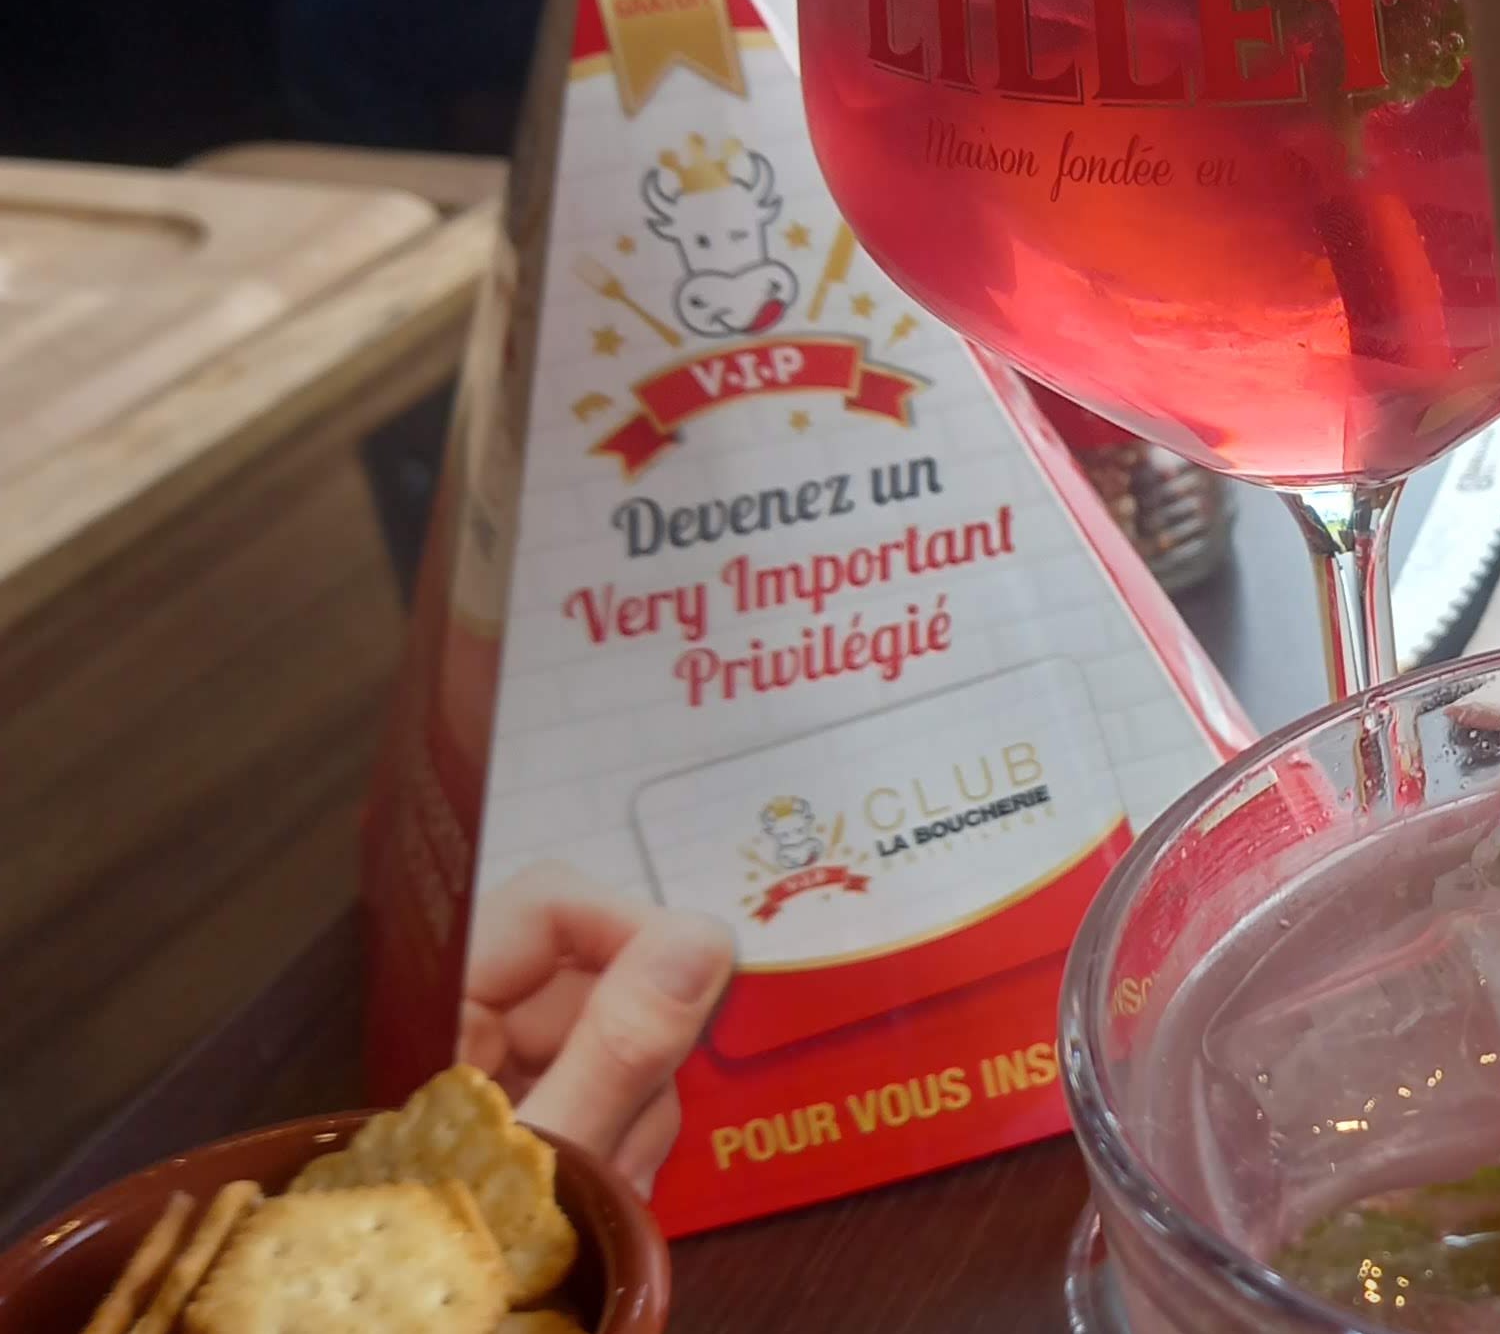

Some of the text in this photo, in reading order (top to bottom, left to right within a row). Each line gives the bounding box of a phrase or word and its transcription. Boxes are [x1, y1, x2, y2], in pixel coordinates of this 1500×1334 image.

[923, 120, 1040, 179] Maison
[1049, 129, 1175, 203] fondée
[1193, 154, 1239, 188] en
[611, 454, 943, 559] Devenez un
[563, 504, 1018, 645] Very Important
[672, 593, 953, 709] Privilégié
[862, 741, 1045, 831] CLUB
[875, 783, 1052, 857] LA BOUCHERIE
[709, 1100, 843, 1171] POUR
[846, 1066, 973, 1135] VOUS
